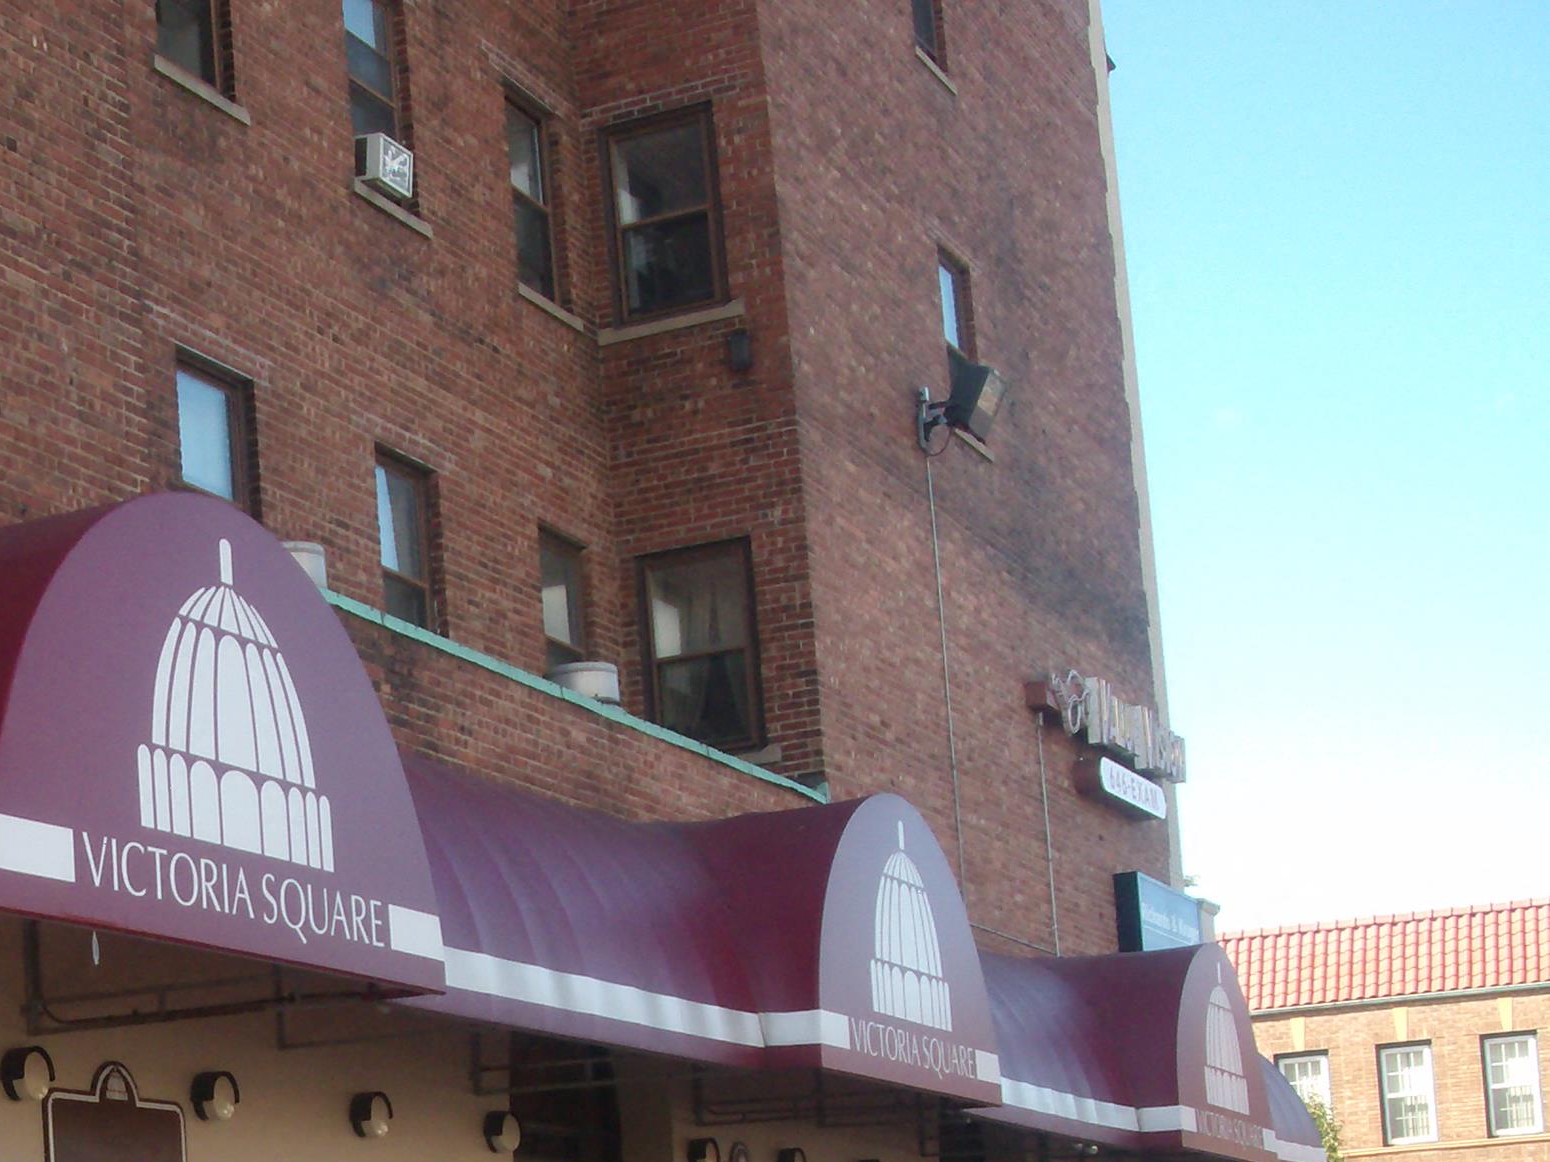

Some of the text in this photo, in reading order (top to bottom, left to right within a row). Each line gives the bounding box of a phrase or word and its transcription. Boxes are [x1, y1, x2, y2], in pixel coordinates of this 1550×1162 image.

[81, 830, 385, 947] VICTORIA SQUARE
[850, 1016, 976, 1080] VICTORIA SQUARE
